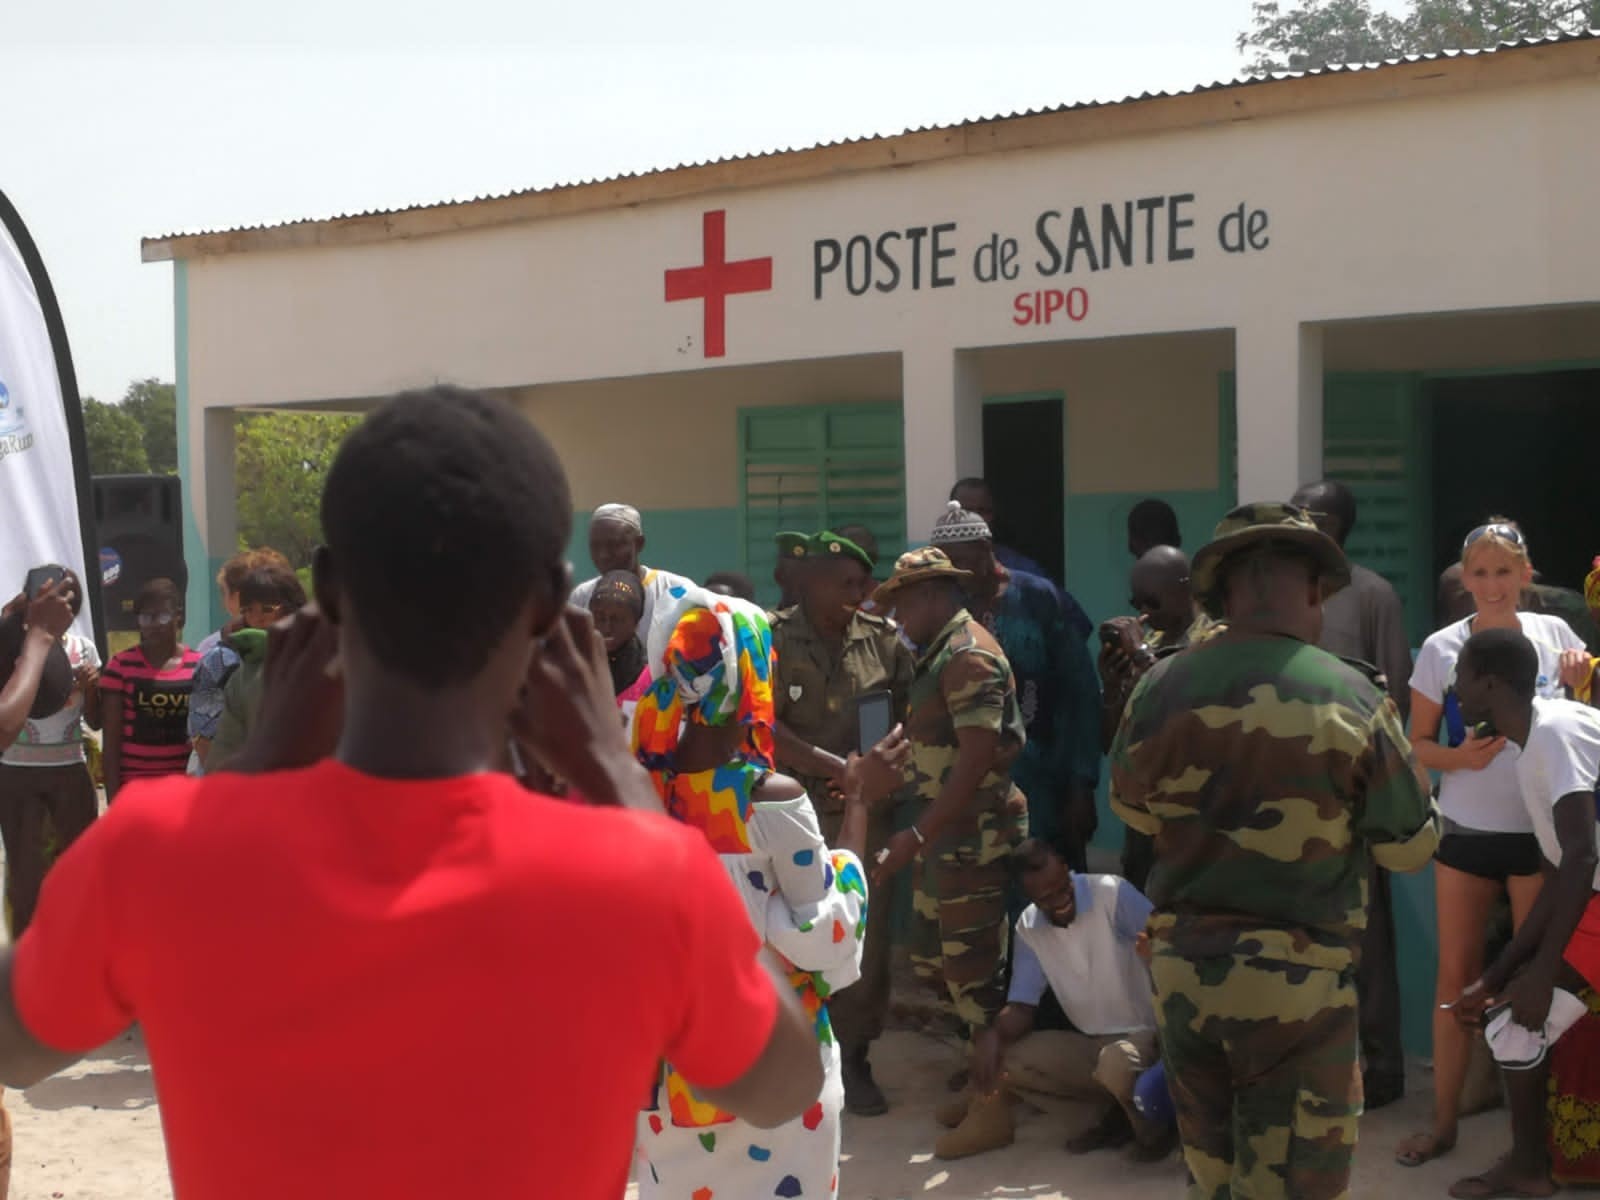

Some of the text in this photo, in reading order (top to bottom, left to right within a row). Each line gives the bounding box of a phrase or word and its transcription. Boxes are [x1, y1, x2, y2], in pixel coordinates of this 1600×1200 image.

[814, 193, 1270, 299] POSTE de SANTE de
[1013, 288, 1089, 325] SIPO
